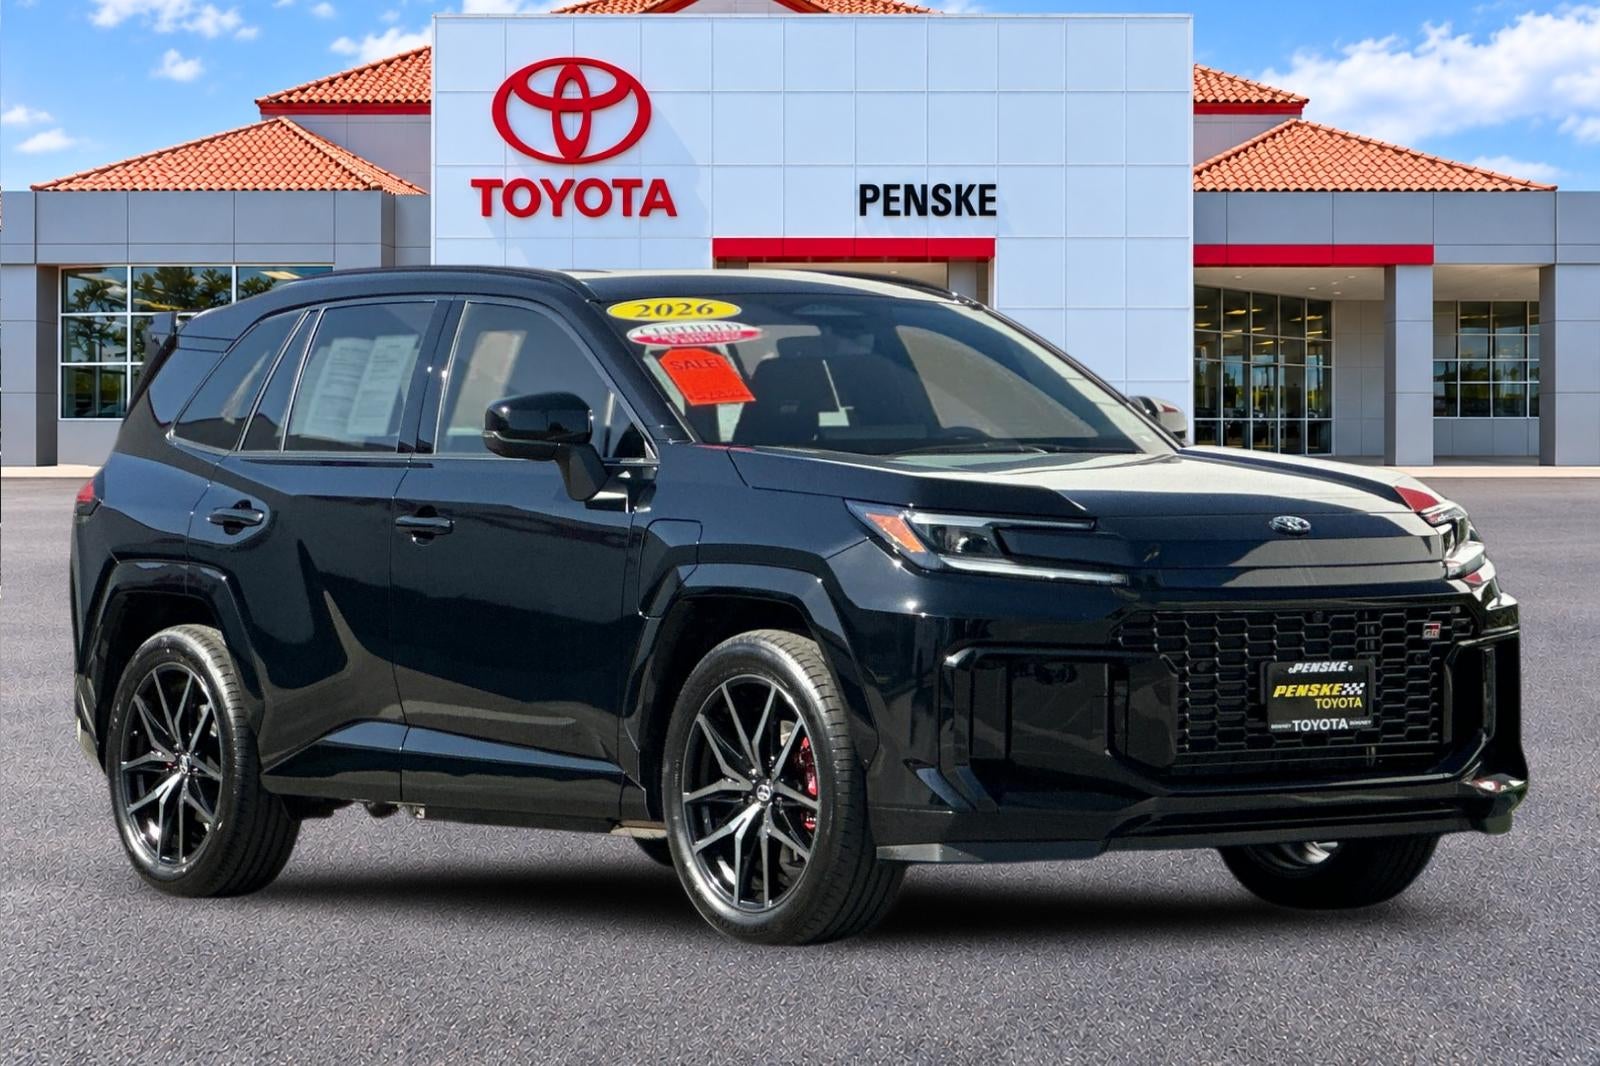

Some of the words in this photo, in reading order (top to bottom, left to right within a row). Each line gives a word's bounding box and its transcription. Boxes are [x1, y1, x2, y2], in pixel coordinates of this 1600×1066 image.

[470, 178, 677, 218] TOYOTA
[859, 183, 997, 217] PENSKE
[635, 302, 714, 317] 2026
[640, 324, 742, 336] CERTIFIED
[1290, 661, 1348, 674] PENSKE
[1273, 683, 1343, 698] PENSKE
[1315, 697, 1363, 710] TOYOTA
[1292, 718, 1349, 732] TOYOTA
